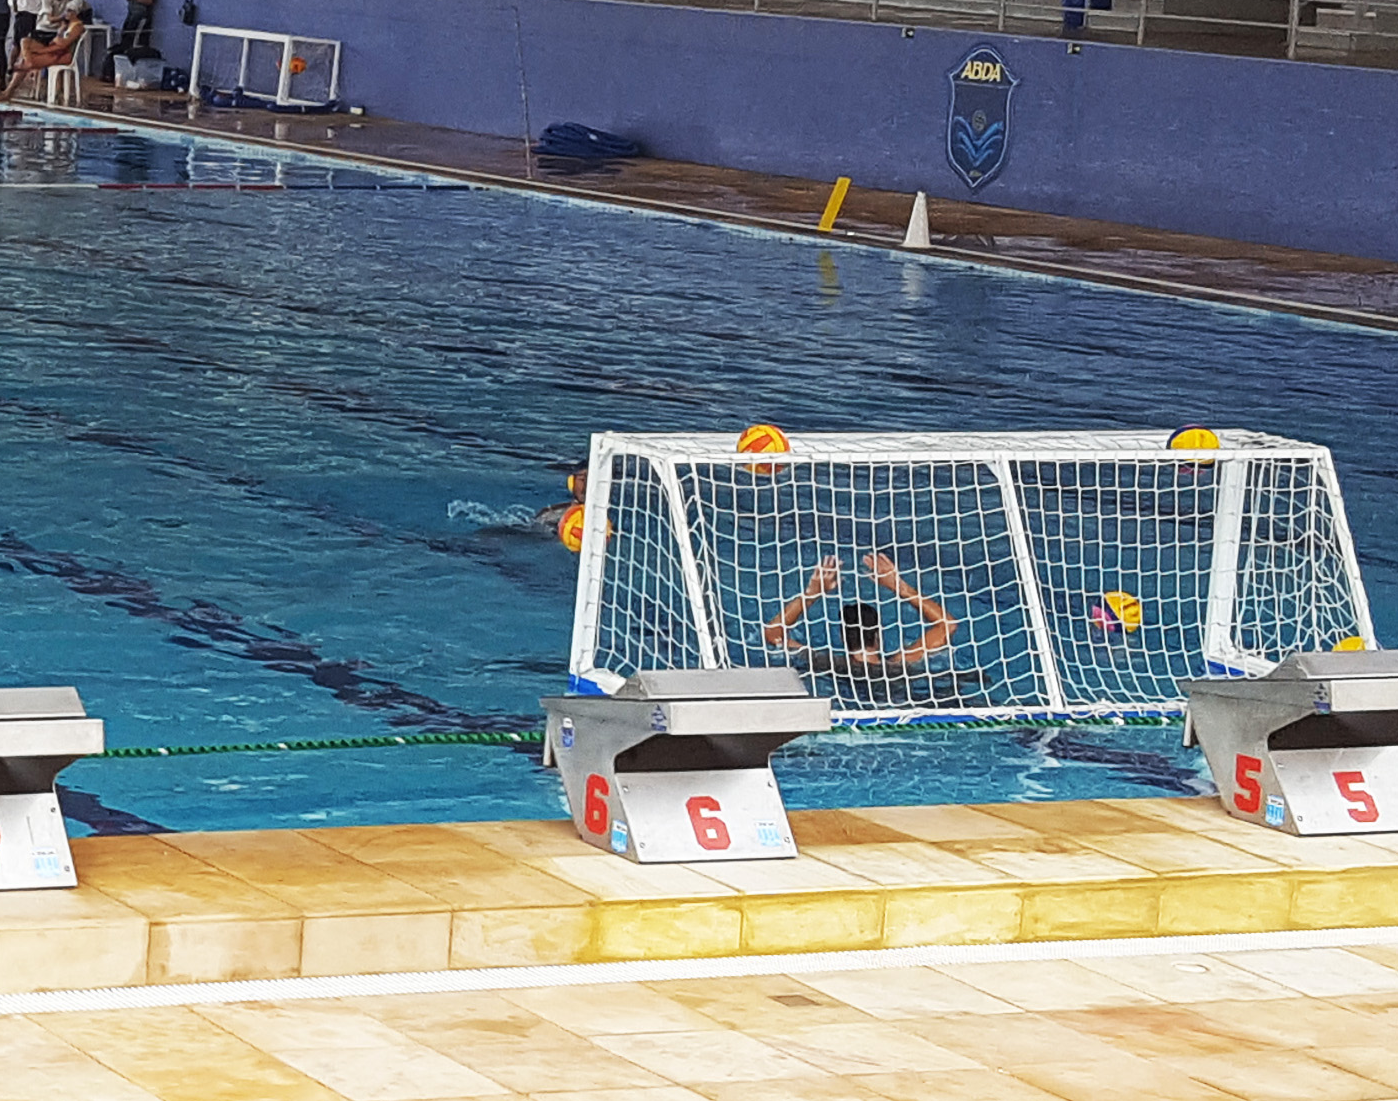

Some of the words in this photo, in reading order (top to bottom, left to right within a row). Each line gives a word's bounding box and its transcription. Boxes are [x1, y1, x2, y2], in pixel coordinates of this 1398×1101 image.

[961, 60, 1002, 82] ABDA
[584, 773, 610, 835] 6
[1234, 753, 1262, 814] 5
[1332, 771, 1380, 823] 5
[686, 796, 731, 850] 6
